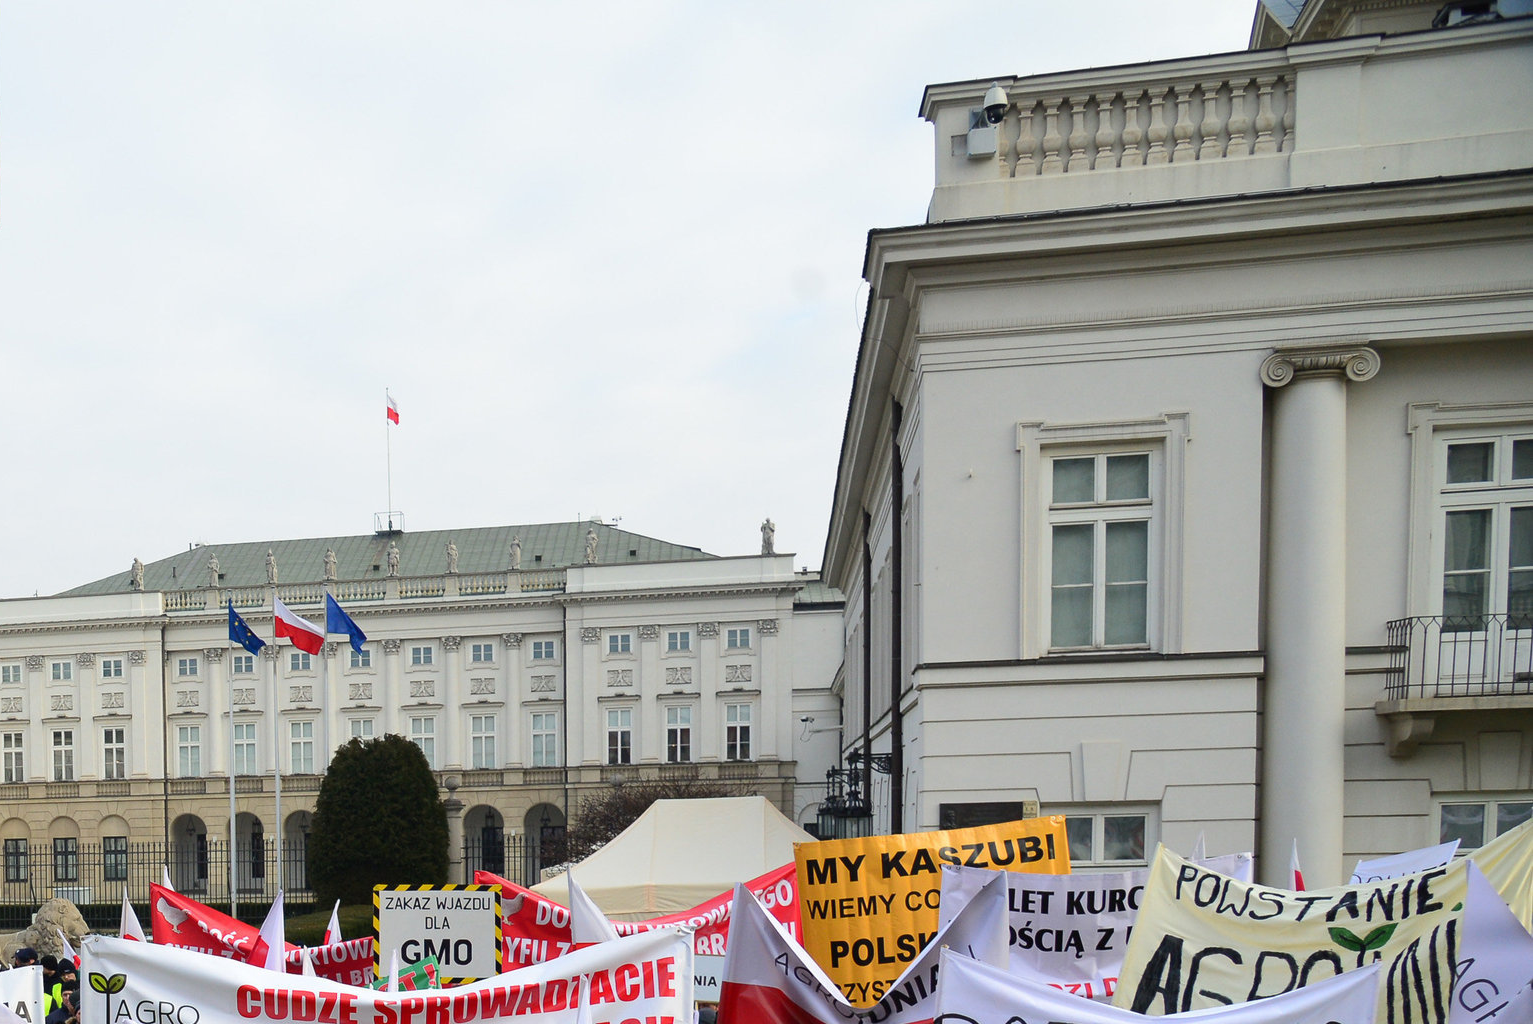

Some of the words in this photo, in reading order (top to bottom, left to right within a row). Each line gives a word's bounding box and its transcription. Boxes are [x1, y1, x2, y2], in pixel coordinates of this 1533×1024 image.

[806, 855, 866, 885] MY
[881, 834, 1056, 879] KASZUBI
[385, 897, 431, 911] ZAKAZ
[436, 897, 491, 911] WJAZDU
[1176, 861, 1447, 923] POWSTANIE
[806, 894, 897, 920] WIEMY
[424, 916, 450, 930] DLA
[401, 938, 474, 966] GMO
[1095, 928, 1115, 952] Z
